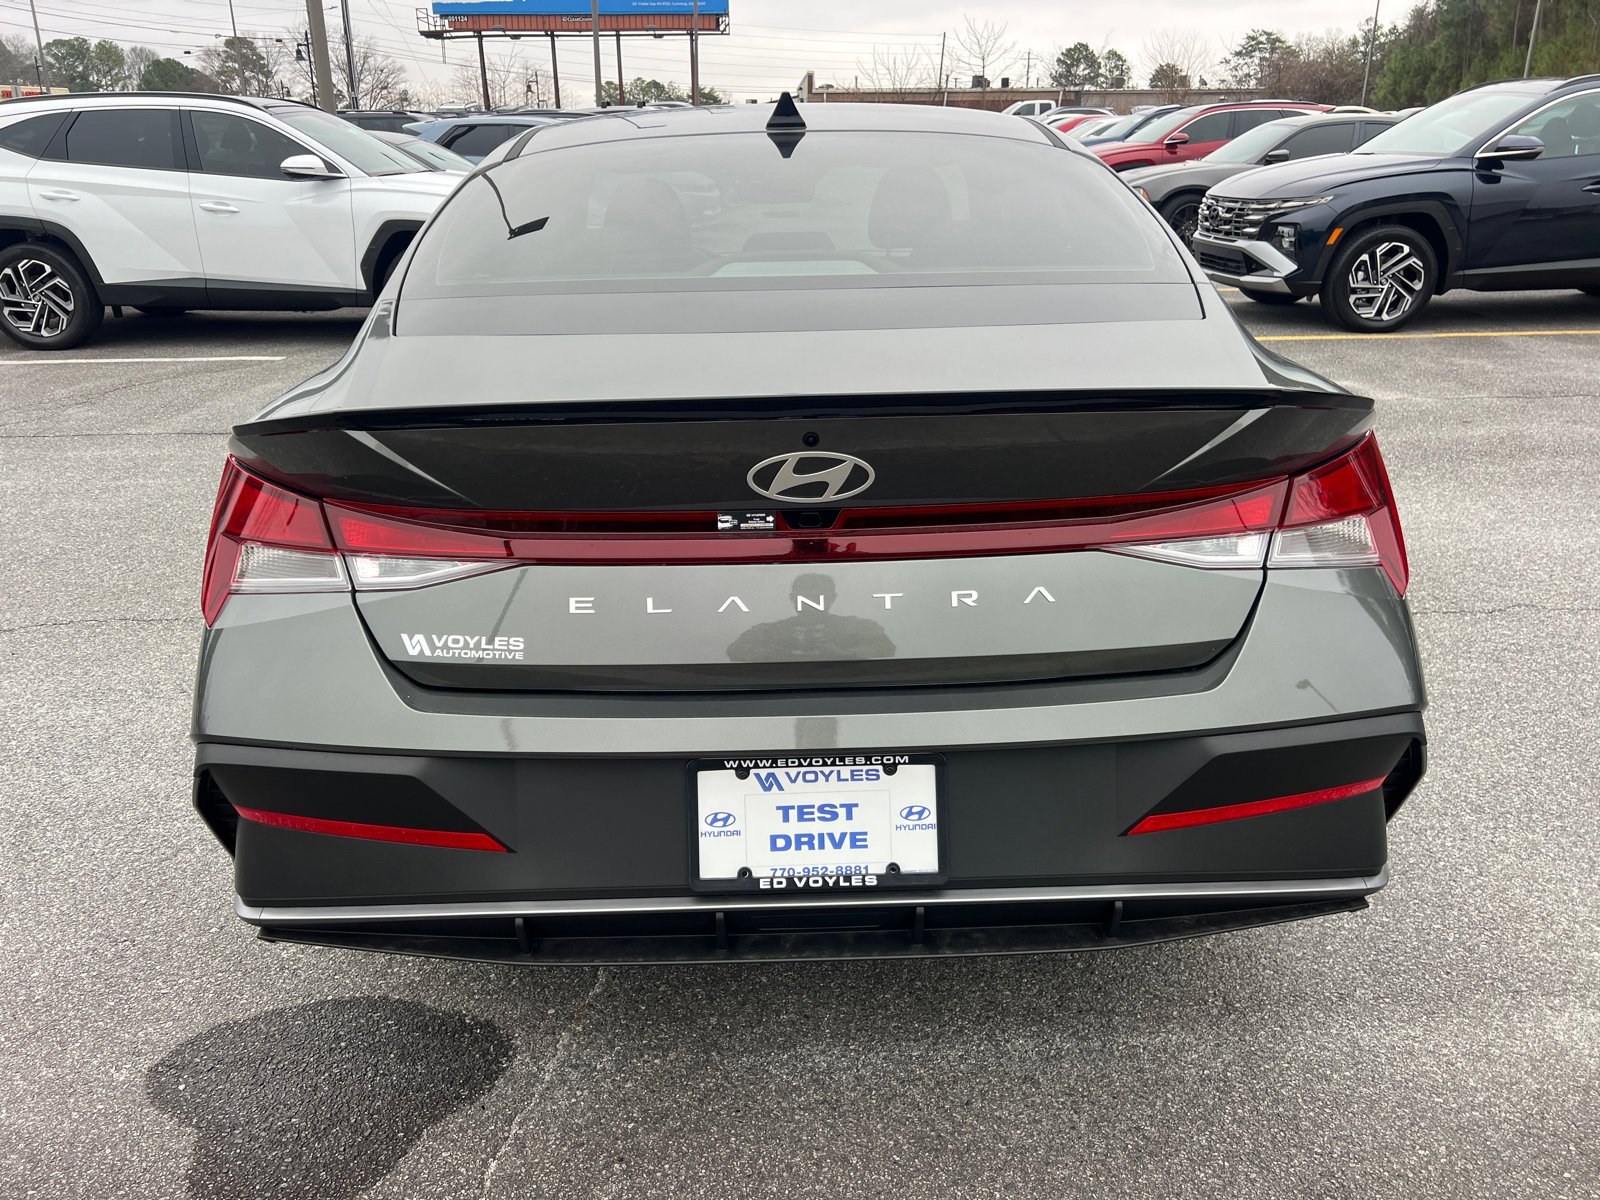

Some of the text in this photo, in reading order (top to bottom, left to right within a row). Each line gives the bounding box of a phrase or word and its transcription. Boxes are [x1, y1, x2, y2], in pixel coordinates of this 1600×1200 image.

[569, 587, 1056, 614] ELANTRA
[432, 635, 524, 650] VOYLES
[433, 649, 524, 660] AUTOMOTIVE
[724, 756, 909, 768] WWW.EDVOYLES.COM
[785, 769, 881, 784] VOYLES
[776, 803, 859, 823] TEST
[700, 830, 741, 838] HYUNDAI
[895, 823, 936, 831] HYUNDAI
[769, 832, 869, 852] DRIVE
[770, 865, 869, 877] 770-952-8881
[759, 875, 878, 889] ED VOYLES
